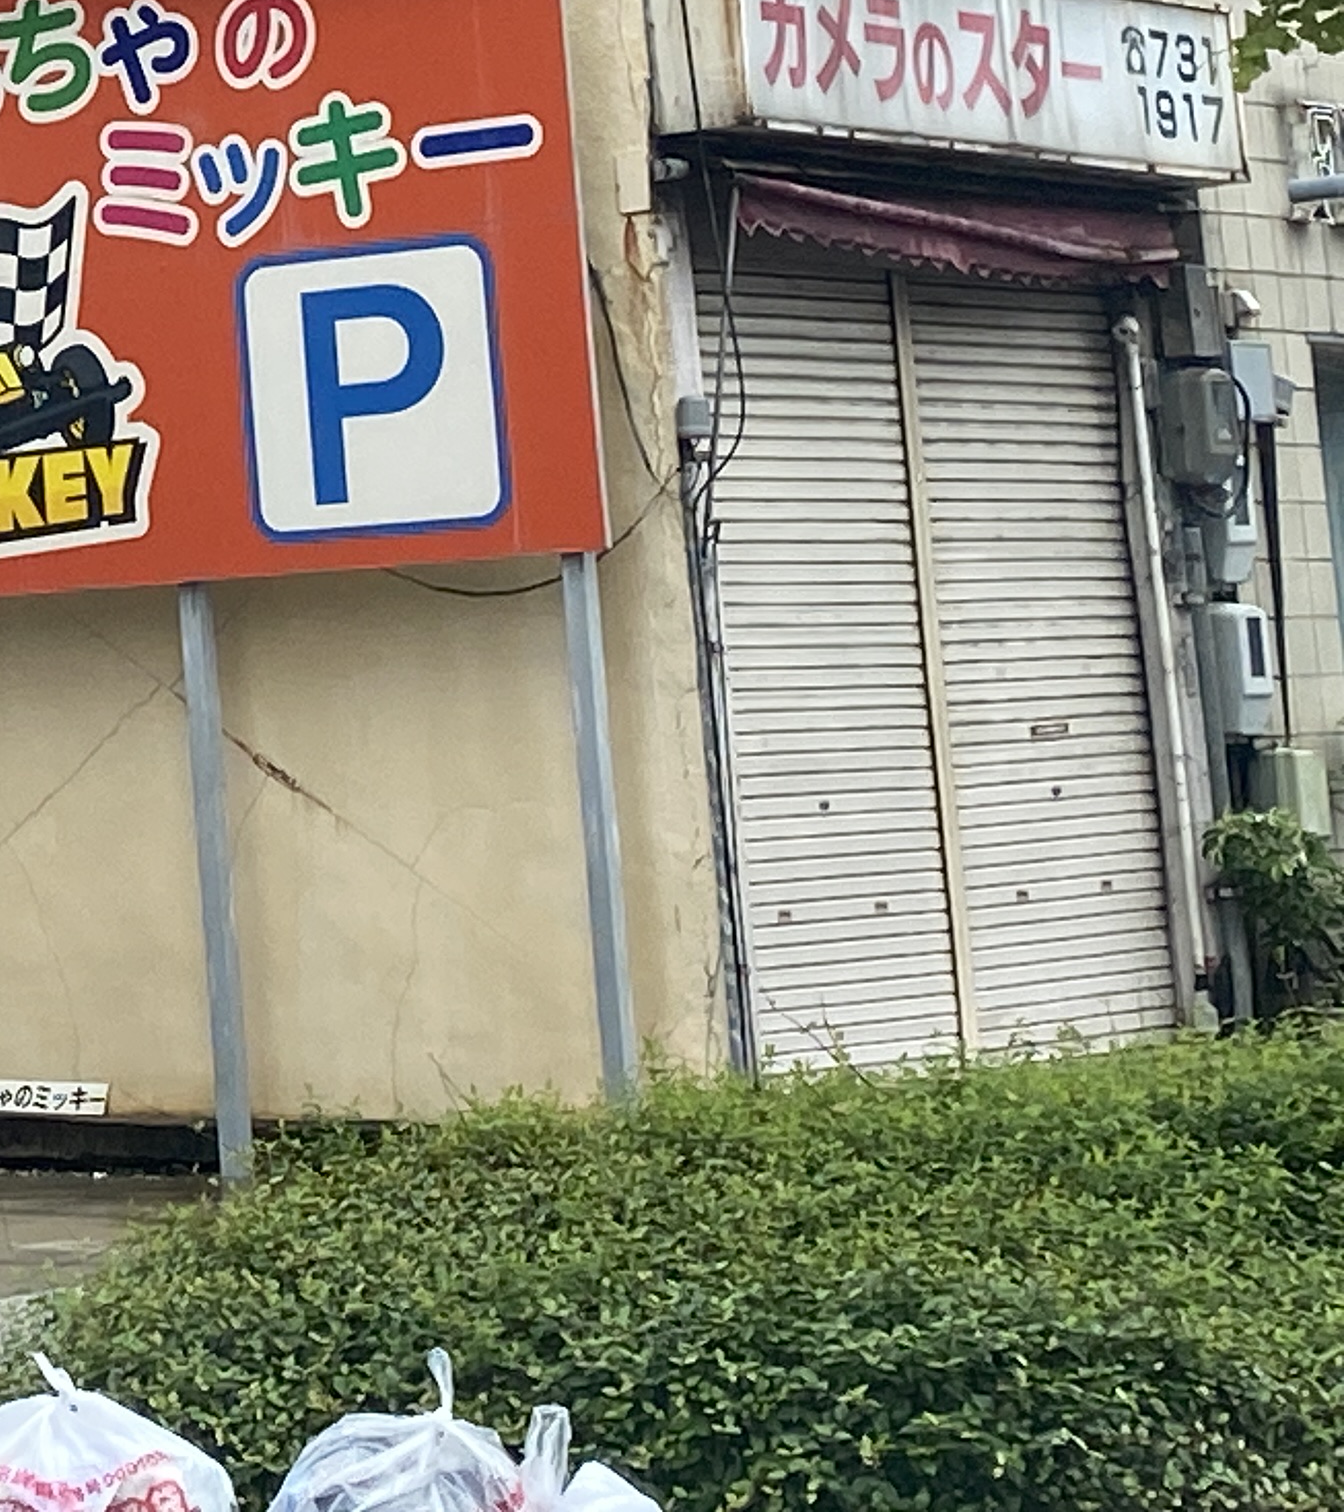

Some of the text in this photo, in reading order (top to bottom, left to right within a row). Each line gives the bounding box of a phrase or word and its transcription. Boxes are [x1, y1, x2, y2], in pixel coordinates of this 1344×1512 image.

[94, 90, 542, 247] ミッキー
[1137, 85, 1224, 145] 1917
[300, 283, 447, 508] P
